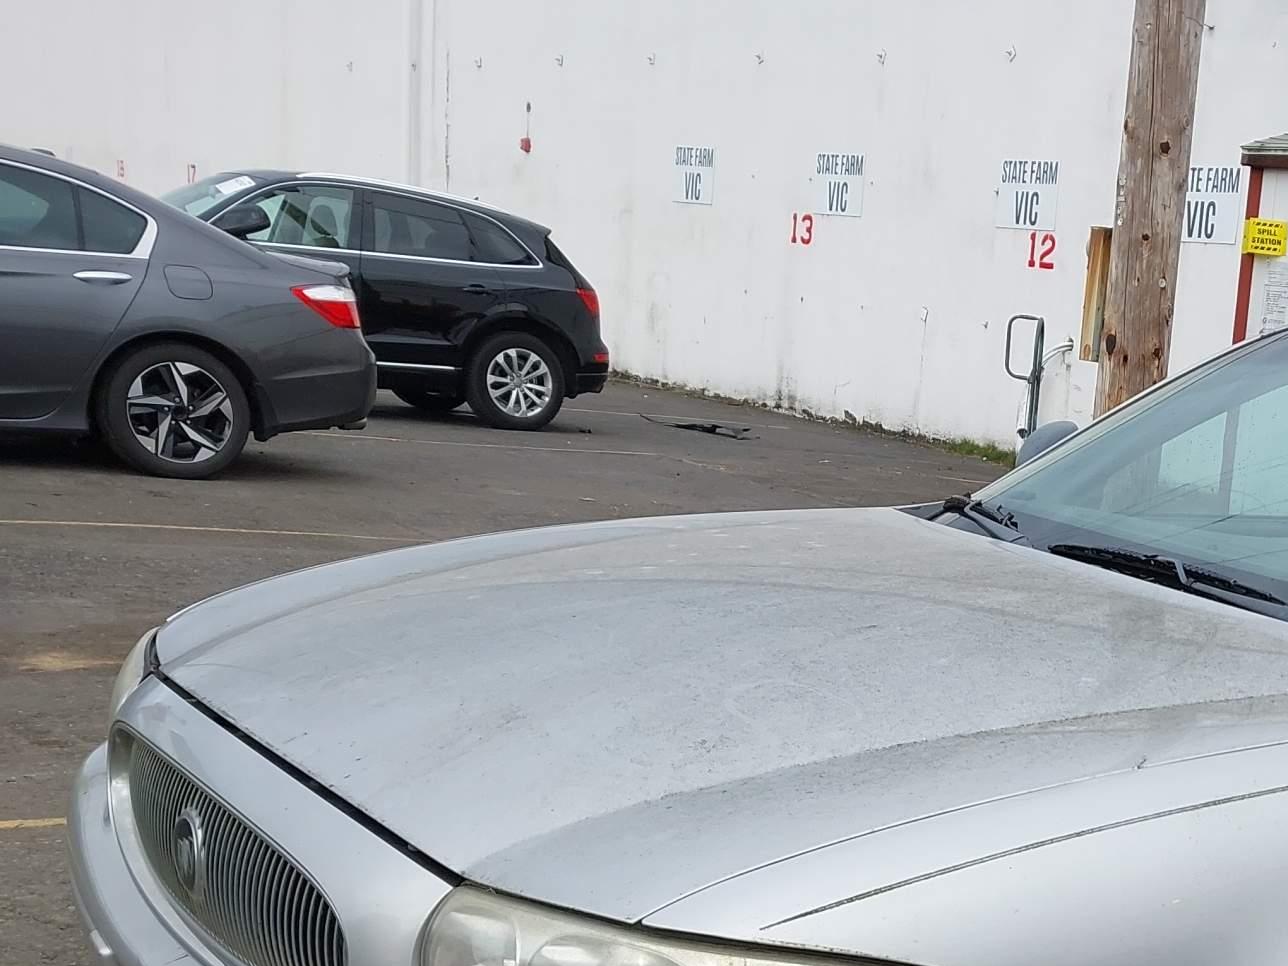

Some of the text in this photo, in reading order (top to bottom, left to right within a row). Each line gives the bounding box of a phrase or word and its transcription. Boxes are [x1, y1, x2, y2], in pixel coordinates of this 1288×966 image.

[675, 146, 714, 168] STATE FARM
[816, 153, 864, 176] STATE FARM
[685, 171, 702, 201] VIC
[1001, 160, 1059, 185] STATE FARM
[1205, 167, 1241, 194] FARM
[828, 181, 848, 212] VIC
[1015, 190, 1040, 226] VIC
[790, 212, 814, 245] 13
[1187, 200, 1216, 239] VIC
[1256, 227, 1278, 237] SPILL
[1028, 231, 1056, 270] 12
[1251, 236, 1282, 246] STATION
